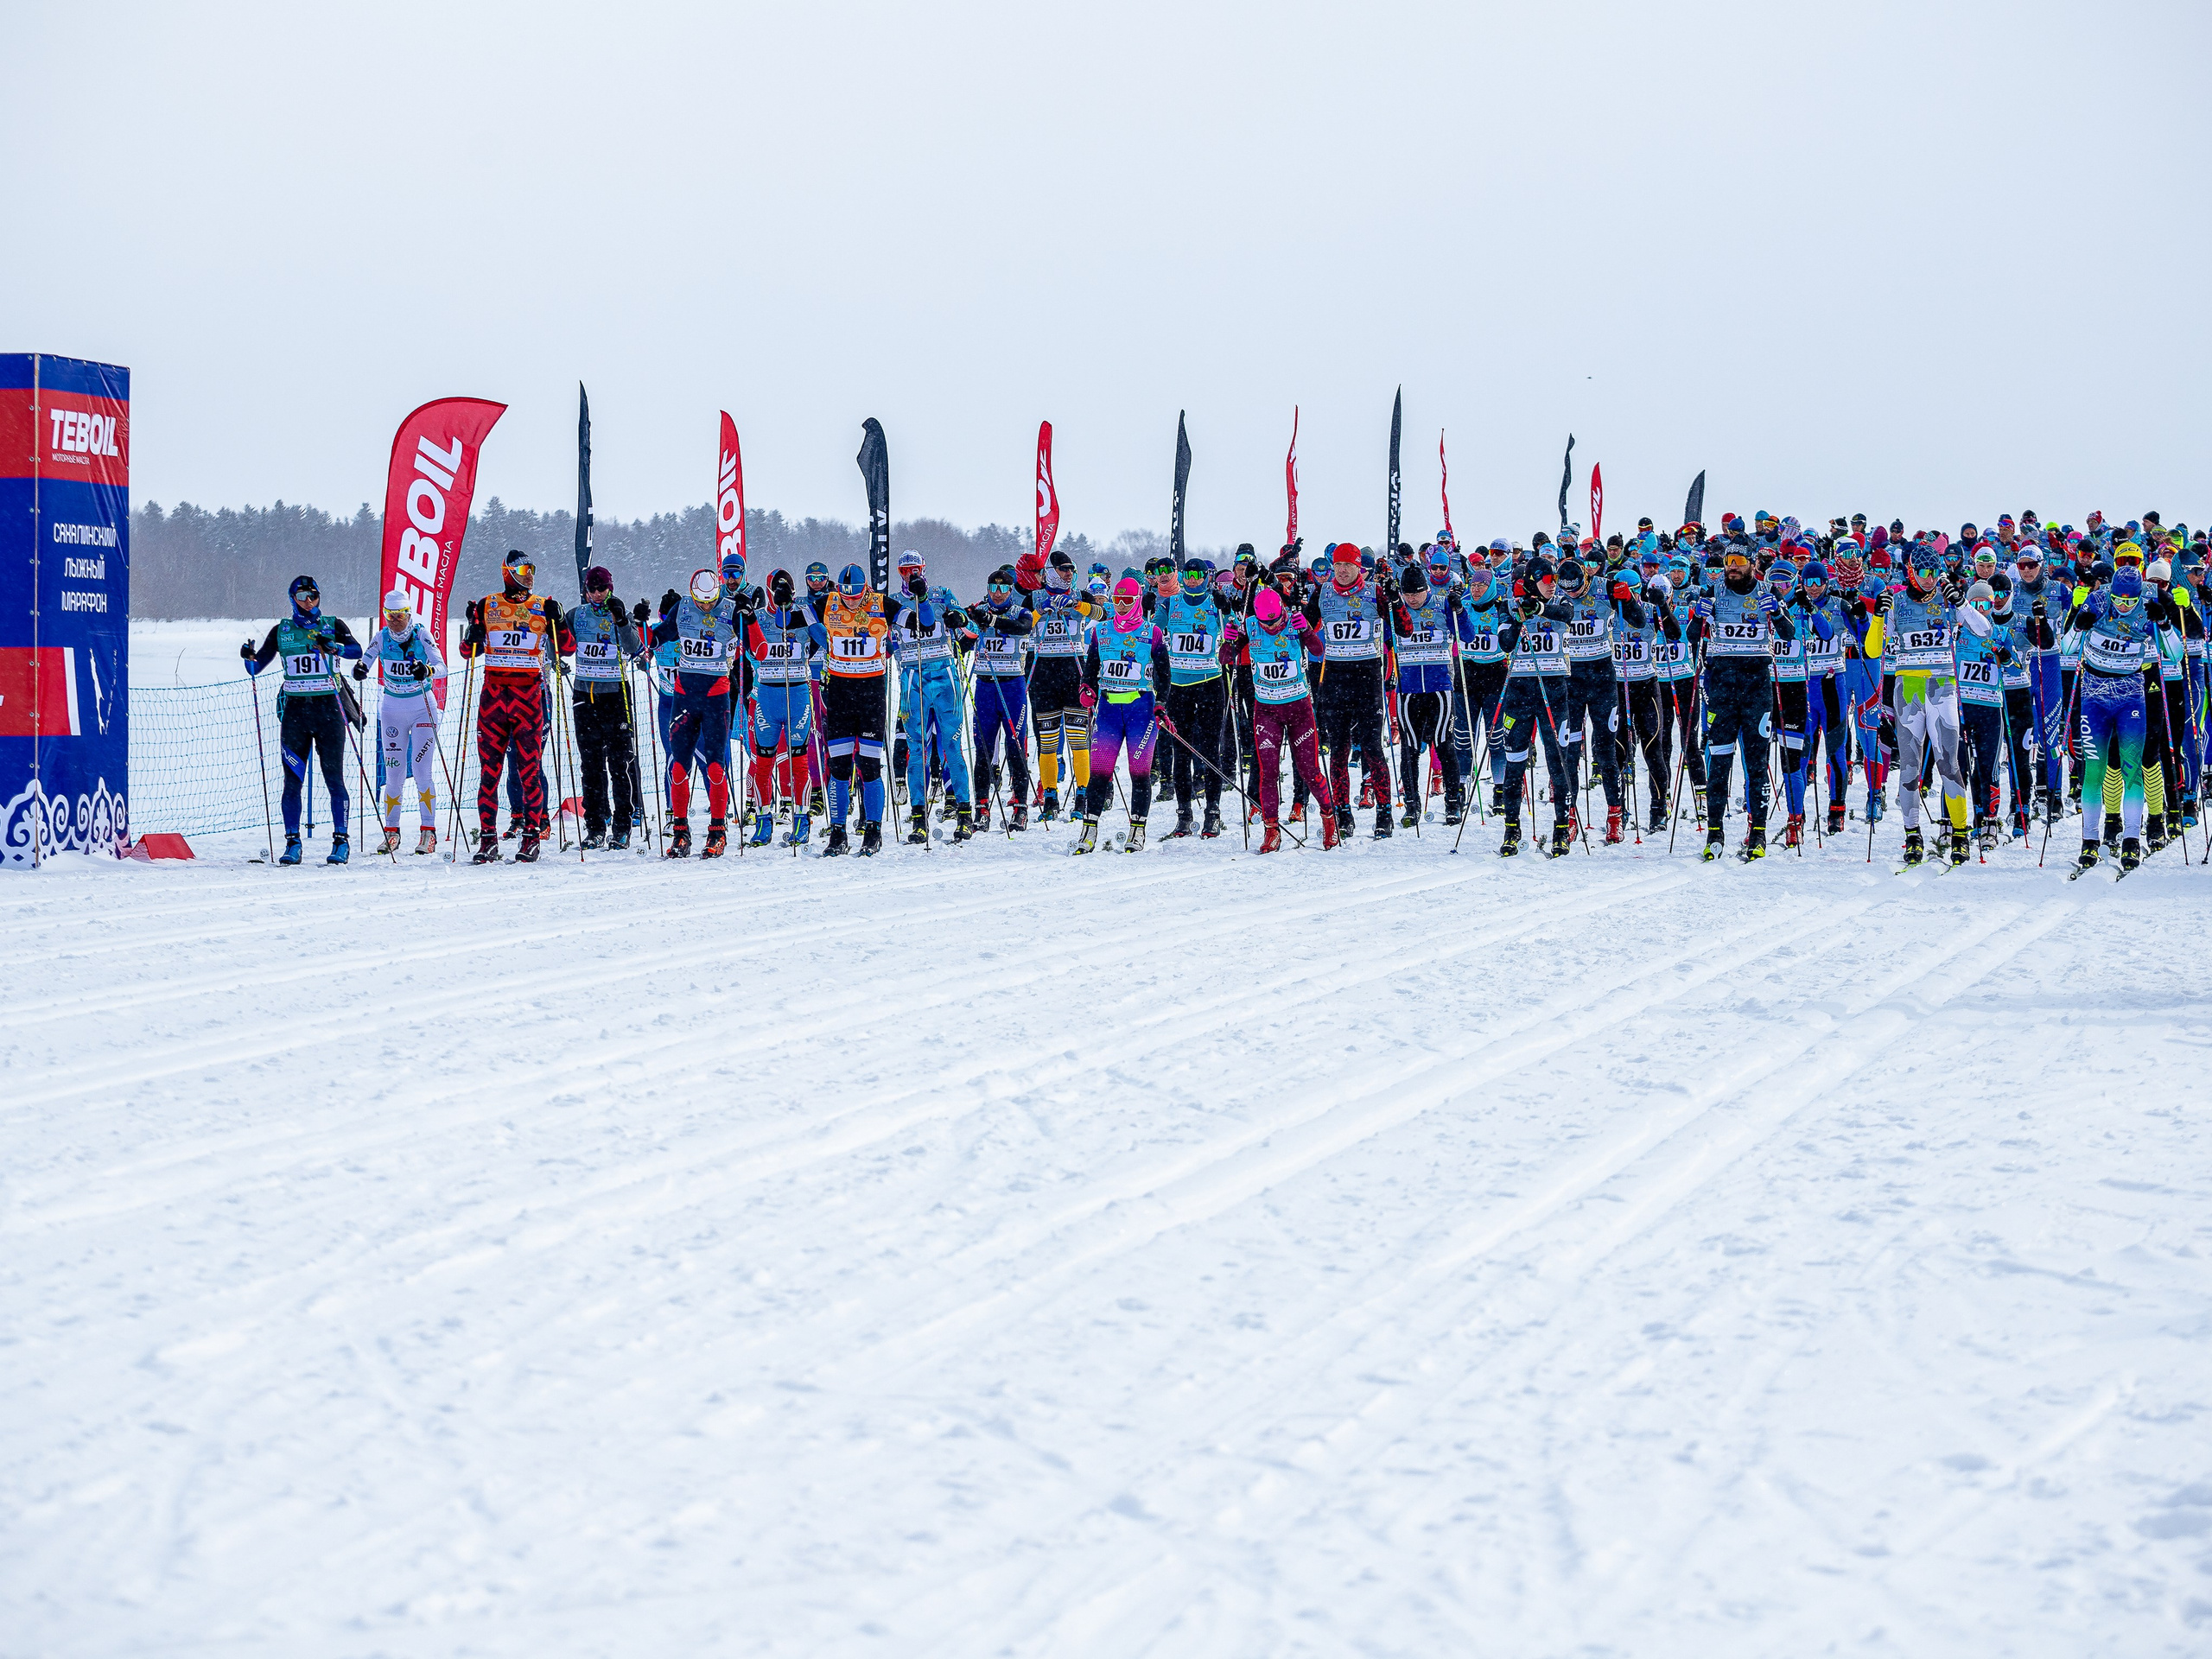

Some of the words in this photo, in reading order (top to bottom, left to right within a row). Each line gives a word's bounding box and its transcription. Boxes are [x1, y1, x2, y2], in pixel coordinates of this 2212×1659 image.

[50, 408, 118, 457] TEBOIL
[54, 521, 117, 548] САХАЛИНСКИЙ
[394, 435, 463, 634] EBOIL
[64, 553, 105, 580] ЛЫЖНЫЙ
[437, 540, 454, 588] МАСЛА
[61, 590, 107, 613] МАРАФОН
[1333, 623, 1362, 639] 672
[1411, 632, 1432, 643] 415
[1569, 622, 1593, 636] 406
[502, 632, 520, 646] 20
[683, 639, 713, 657] 645
[842, 639, 865, 655] 111
[986, 639, 1003, 652] 412
[1178, 634, 1205, 652] 704
[1521, 634, 1554, 652] 630
[1910, 632, 1945, 647] 632
[2101, 639, 2126, 653] 401
[584, 645, 607, 658] 404
[1615, 643, 1642, 660] 636
[1656, 645, 1679, 662] 129
[293, 656, 320, 674] 191
[1108, 662, 1131, 677] 407
[1263, 664, 1287, 679] 402
[1963, 663, 1991, 683] 726
[1016, 703, 1027, 733] REGION
[1139, 720, 1155, 752] REGION
[1294, 728, 1314, 747] LUKOIL
[2081, 715, 2100, 760] КОМИ
[415, 741, 431, 763] CRAFT
[830, 779, 838, 818] SAKHALIN
